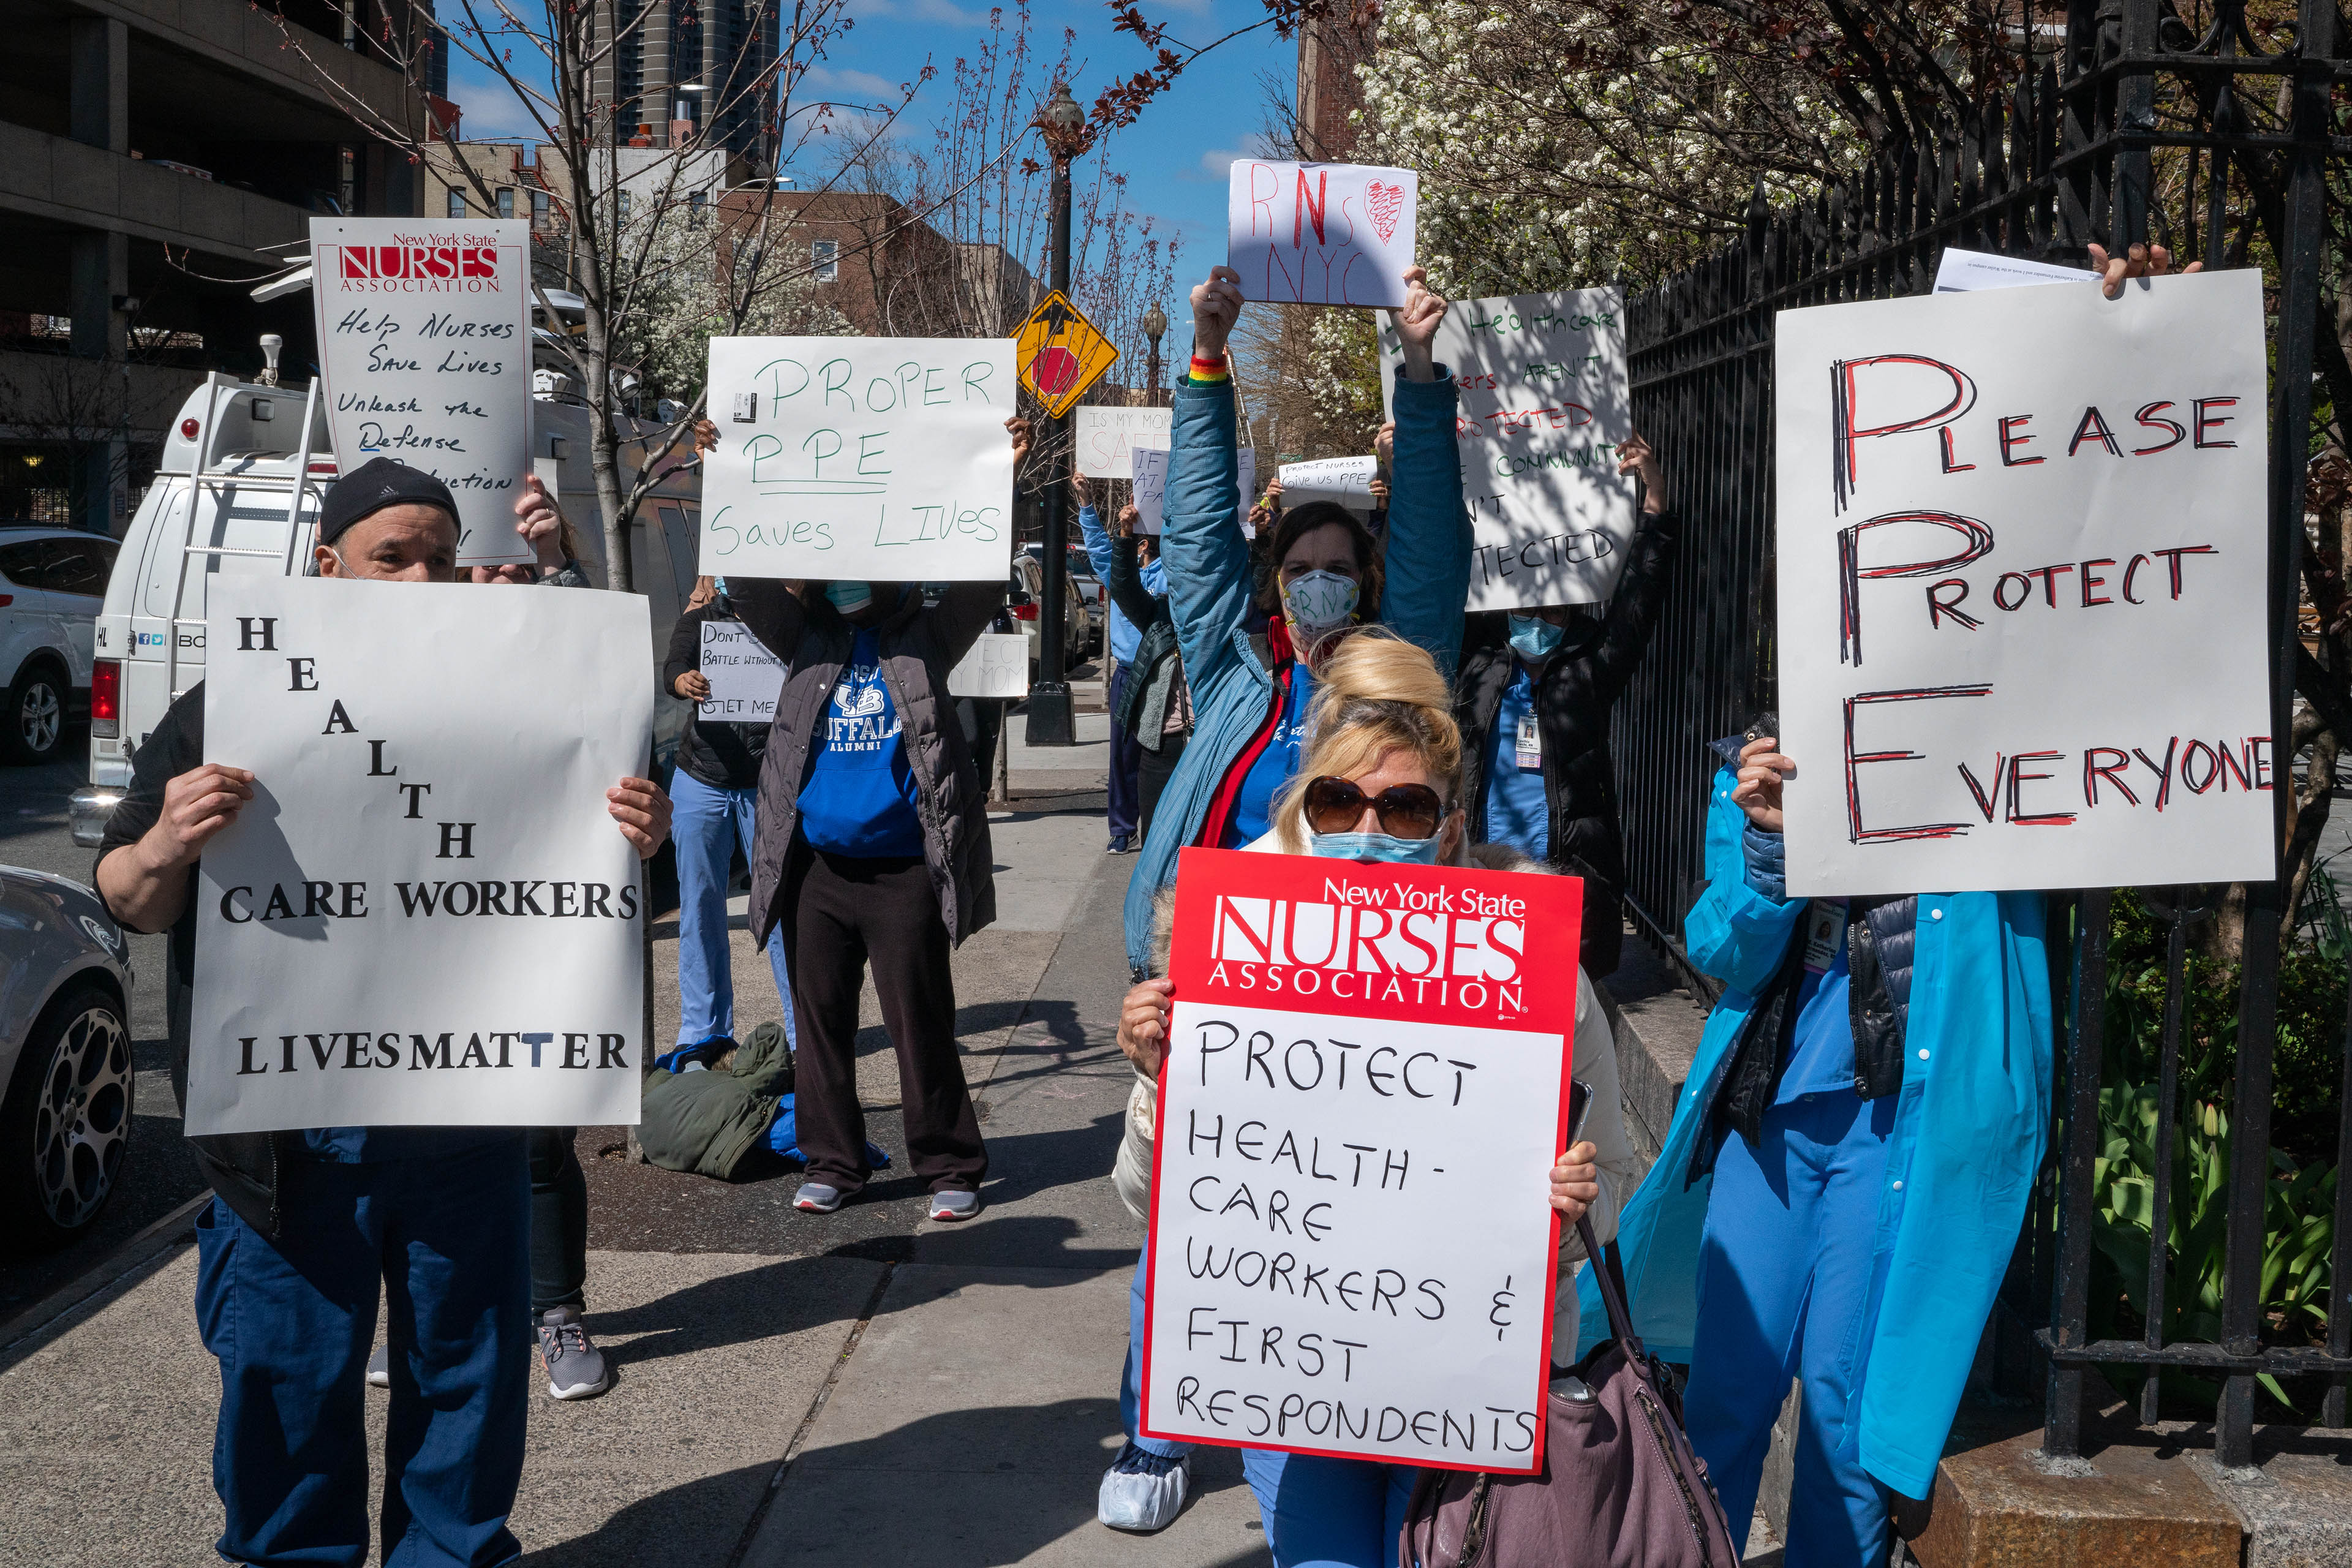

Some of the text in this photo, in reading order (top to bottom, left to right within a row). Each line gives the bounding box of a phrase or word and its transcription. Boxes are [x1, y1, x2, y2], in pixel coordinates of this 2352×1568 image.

[394, 233, 496, 246] New York State
[340, 246, 497, 279] NURSES
[1267, 243, 1363, 306] NYC
[341, 279, 499, 293] ASSOCIATION
[336, 307, 400, 341] Help
[1471, 307, 1617, 337] Healthcare
[754, 358, 995, 419] PROPER
[1452, 372, 1497, 390] ers
[445, 400, 489, 418] the
[1088, 413, 1107, 427] IS
[1116, 413, 1133, 428] MY
[1457, 402, 1593, 440] ROTECTED
[359, 421, 466, 453] Defense
[1830, 353, 2241, 517] PLEASE
[743, 429, 892, 483] PPE
[1340, 473, 1368, 486] PPE
[711, 505, 834, 555] Saves
[1473, 529, 1615, 586] TECTED
[1297, 584, 1338, 619] RN
[1838, 510, 2219, 667] PROTECT
[704, 624, 744, 644] DONT
[962, 639, 1028, 663] TECT
[703, 649, 739, 665] BATTLE
[744, 655, 777, 665] WITHOUT
[978, 666, 1023, 692] MOM
[752, 700, 774, 714] ME
[236, 617, 477, 858] HEALTH
[830, 742, 881, 752] ALUMNI
[1843, 683, 2274, 845] EVERYONE
[220, 880, 638, 924] CARE WORKERS
[1324, 877, 1525, 918] New York State
[1211, 895, 1525, 985] NURSES
[1208, 961, 1522, 1012] ASSOCIATION
[1196, 1020, 1476, 1106] PROTECT
[1190, 1176, 1331, 1242] CARE
[1188, 1236, 1515, 1341] WORKERS &
[1188, 1307, 1367, 1382] FIRST
[1178, 1376, 1542, 1452] RESPONDENTS
